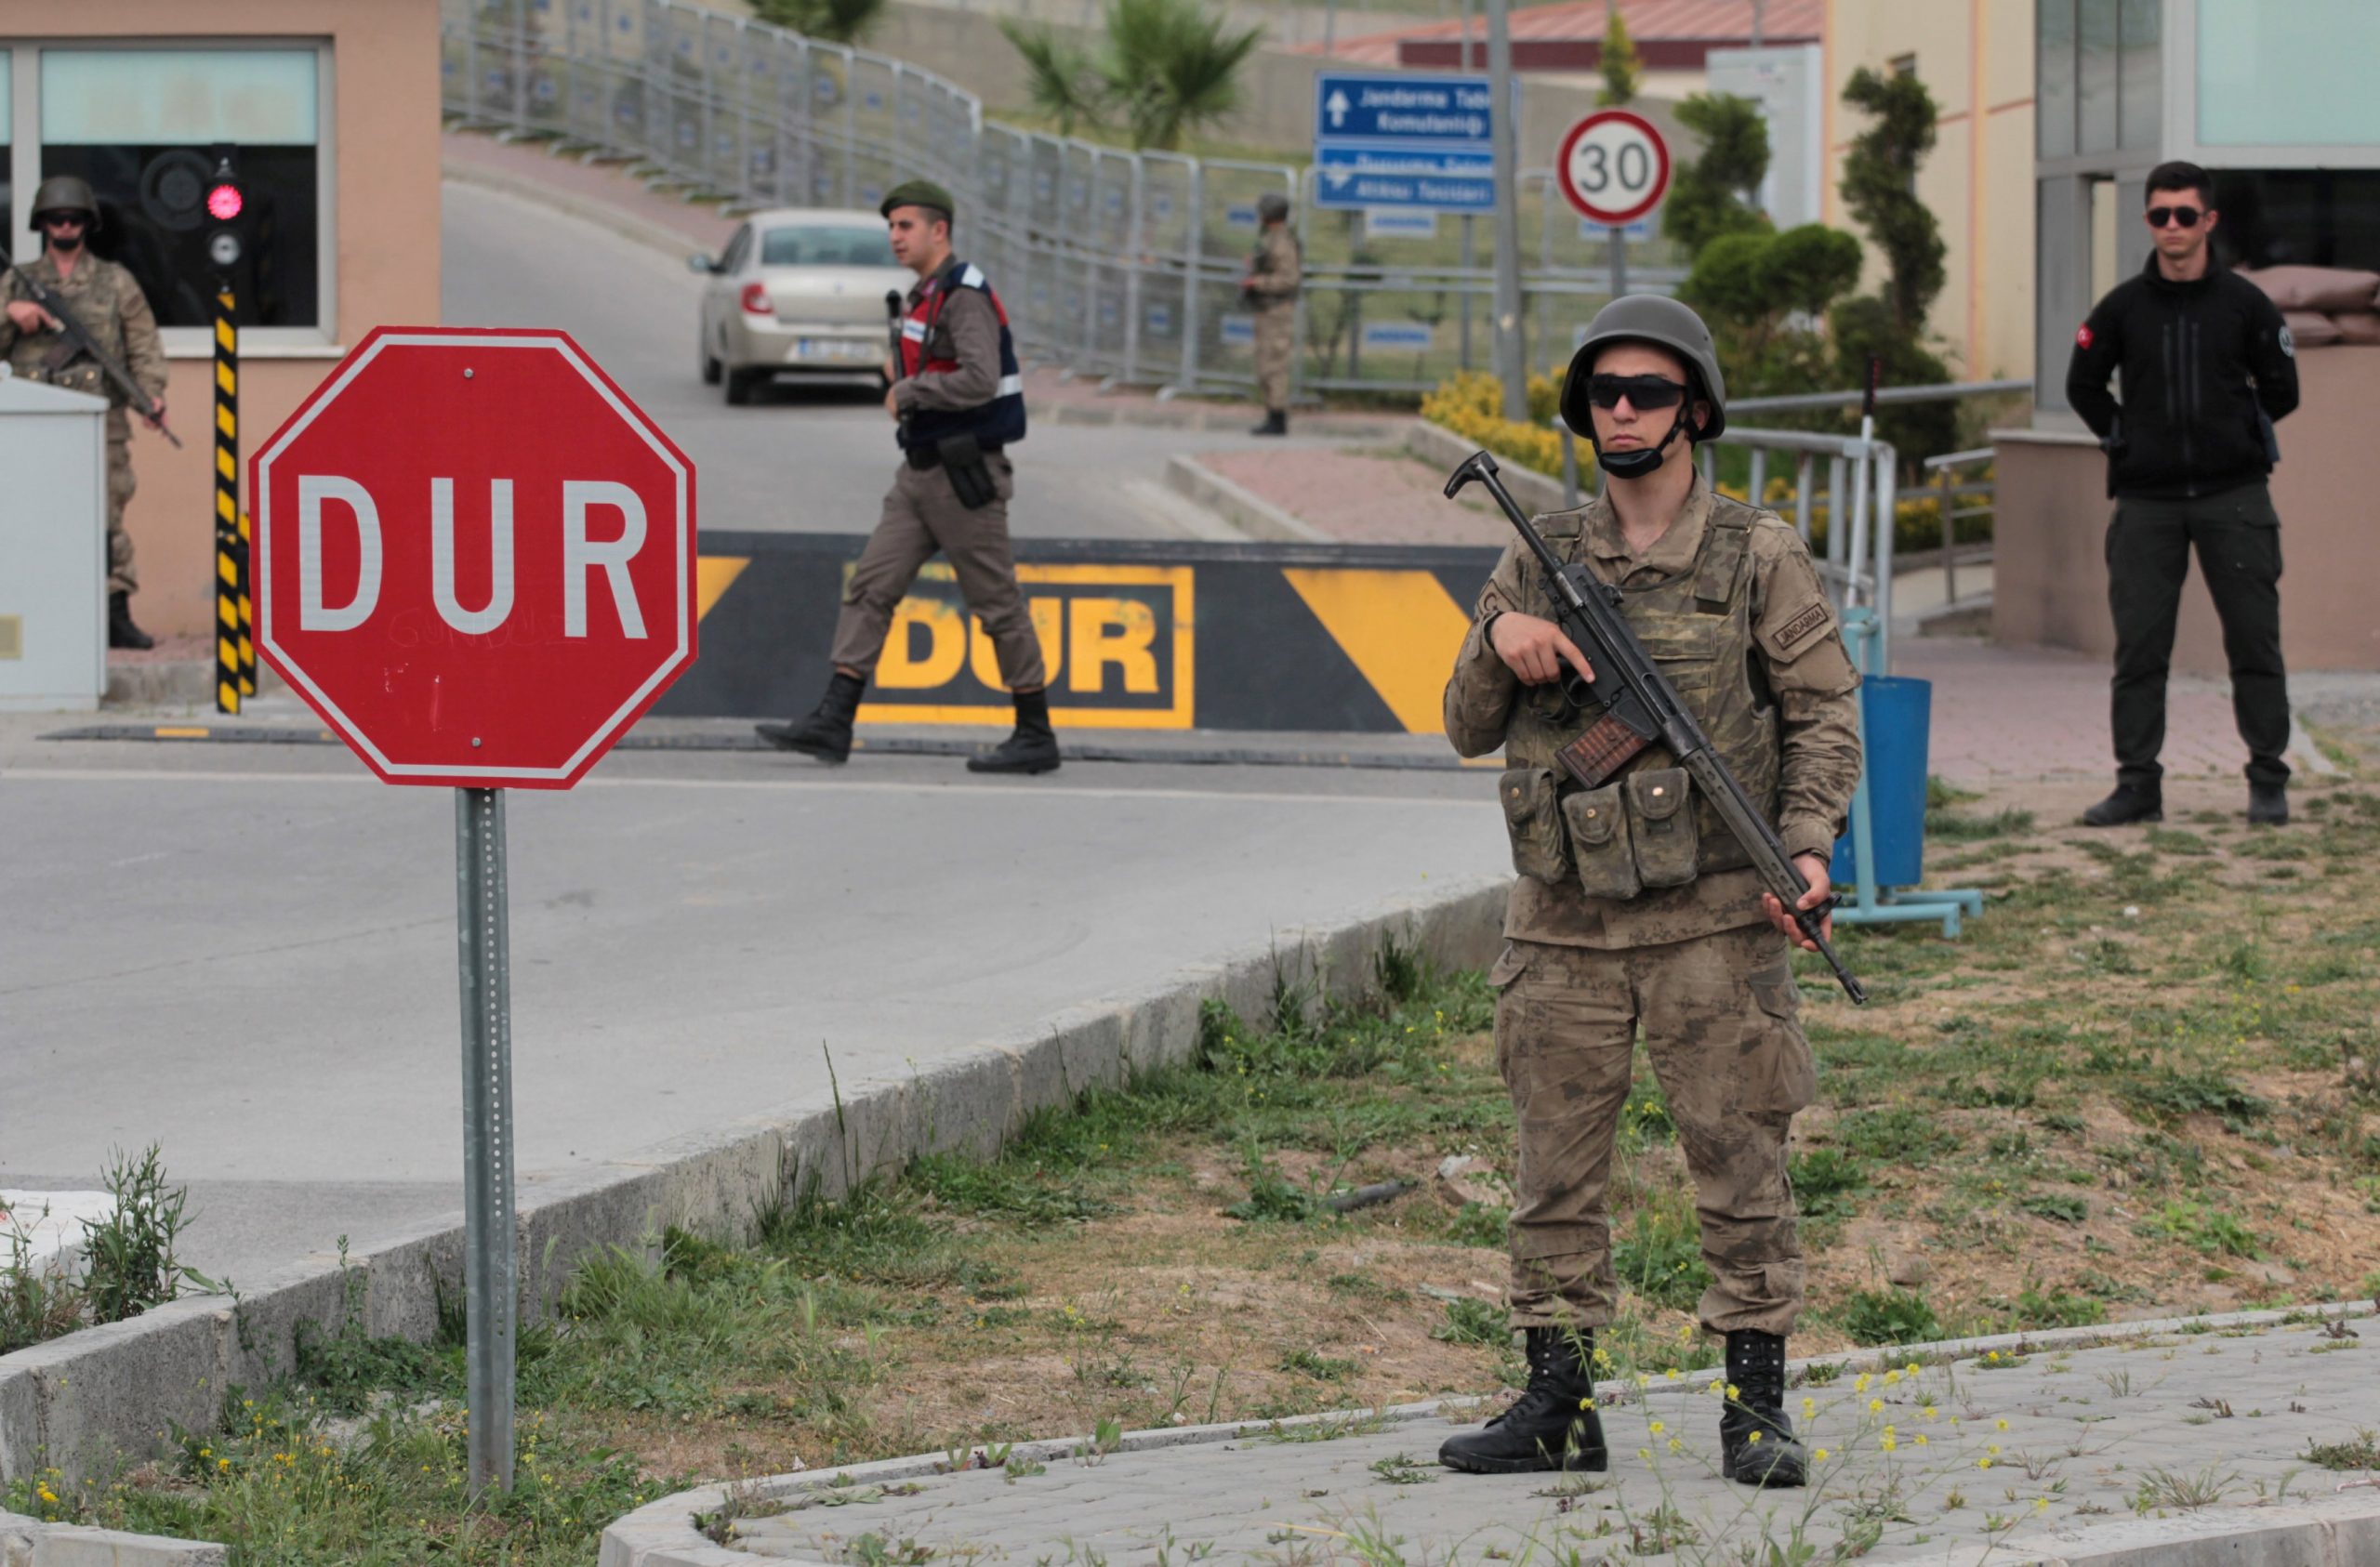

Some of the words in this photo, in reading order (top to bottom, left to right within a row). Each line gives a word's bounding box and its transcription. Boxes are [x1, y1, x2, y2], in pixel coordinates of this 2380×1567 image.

[1360, 88, 1448, 108] Jandarma
[1456, 89, 1491, 109] Tab
[1580, 141, 1649, 192] 30
[298, 475, 648, 639] DUR
[875, 596, 1159, 693] DUR
[1779, 609, 1824, 644] JANDARMA
